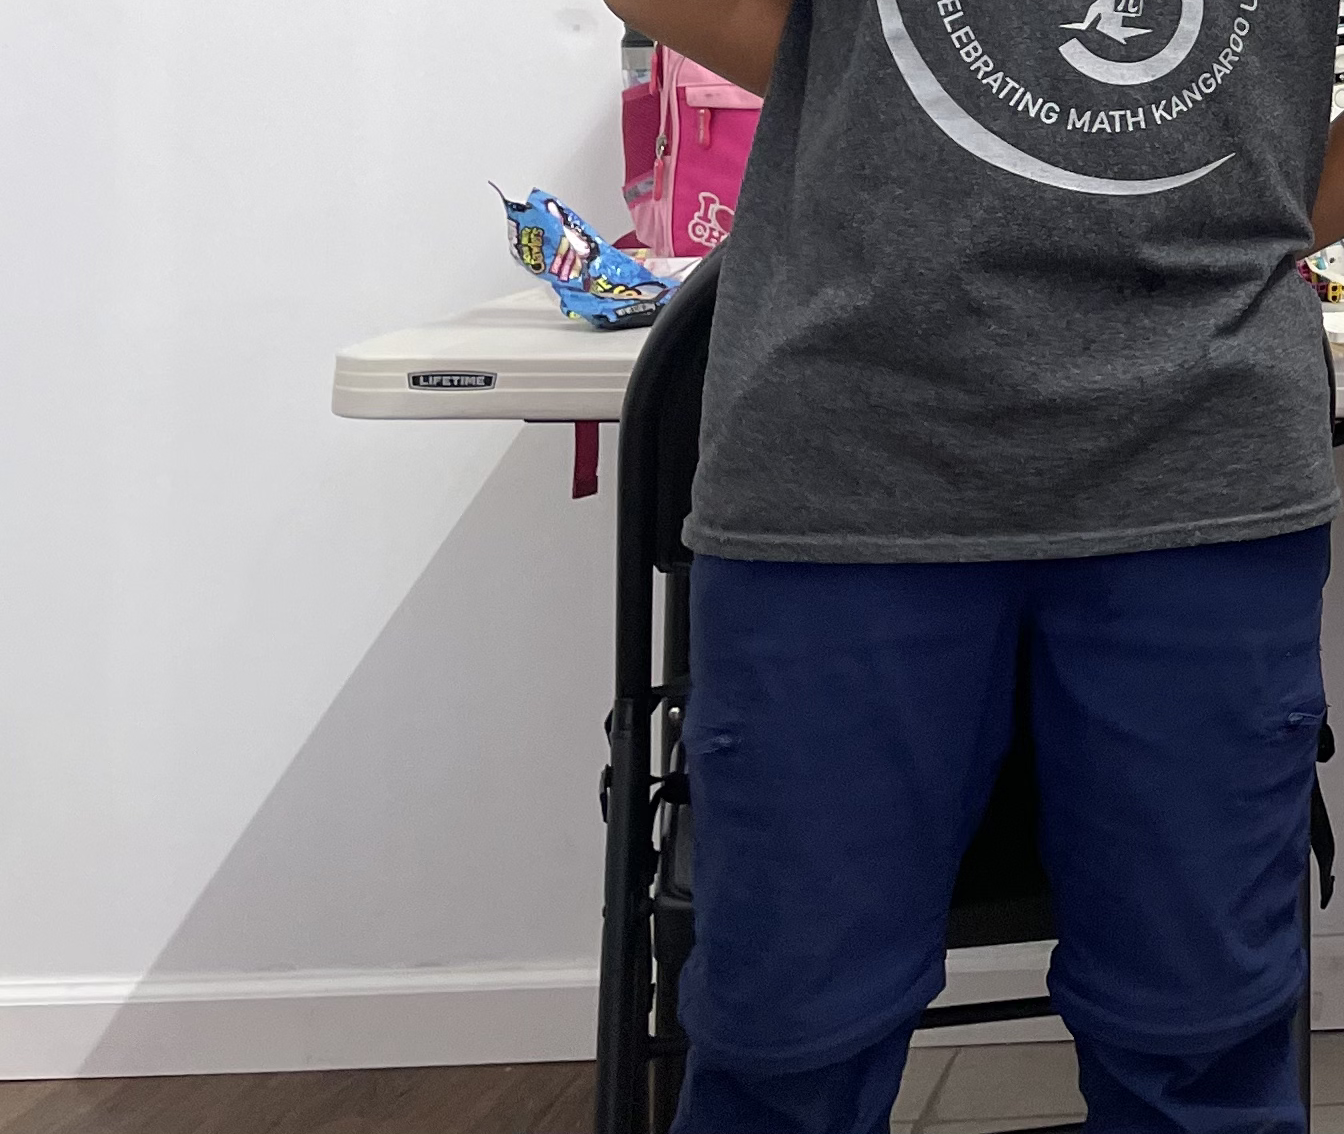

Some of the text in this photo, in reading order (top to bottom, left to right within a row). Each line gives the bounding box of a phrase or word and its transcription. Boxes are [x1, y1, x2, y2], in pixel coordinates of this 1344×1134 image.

[1067, 107, 1146, 133] MATH
[1152, 16, 1250, 125] KANGAROO
[419, 375, 486, 386] LIFETIME
